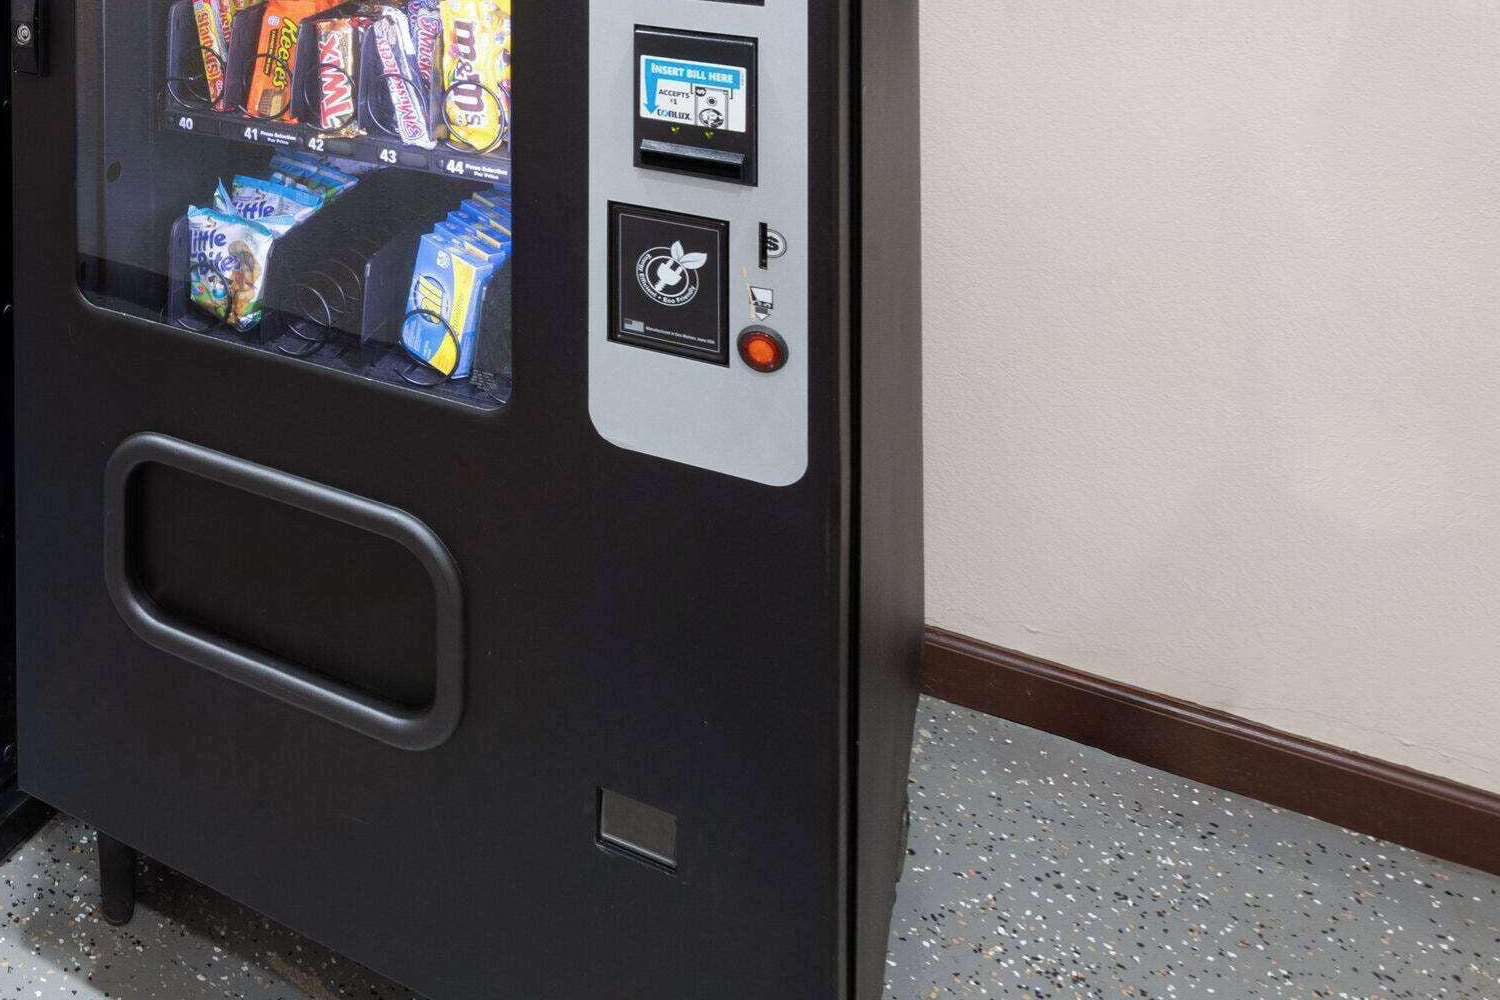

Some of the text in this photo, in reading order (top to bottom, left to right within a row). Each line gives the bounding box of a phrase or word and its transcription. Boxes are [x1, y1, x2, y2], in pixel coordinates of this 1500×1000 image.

[651, 63, 684, 77] INSERT
[686, 69, 706, 80] BILL
[708, 72, 734, 83] HERE
[318, 33, 354, 129] TWIX
[659, 89, 690, 99] ACCEPTS
[179, 117, 193, 130] 40
[244, 127, 258, 140] 41
[308, 138, 324, 151] 42
[380, 149, 397, 164] 43
[446, 160, 464, 174] 44
